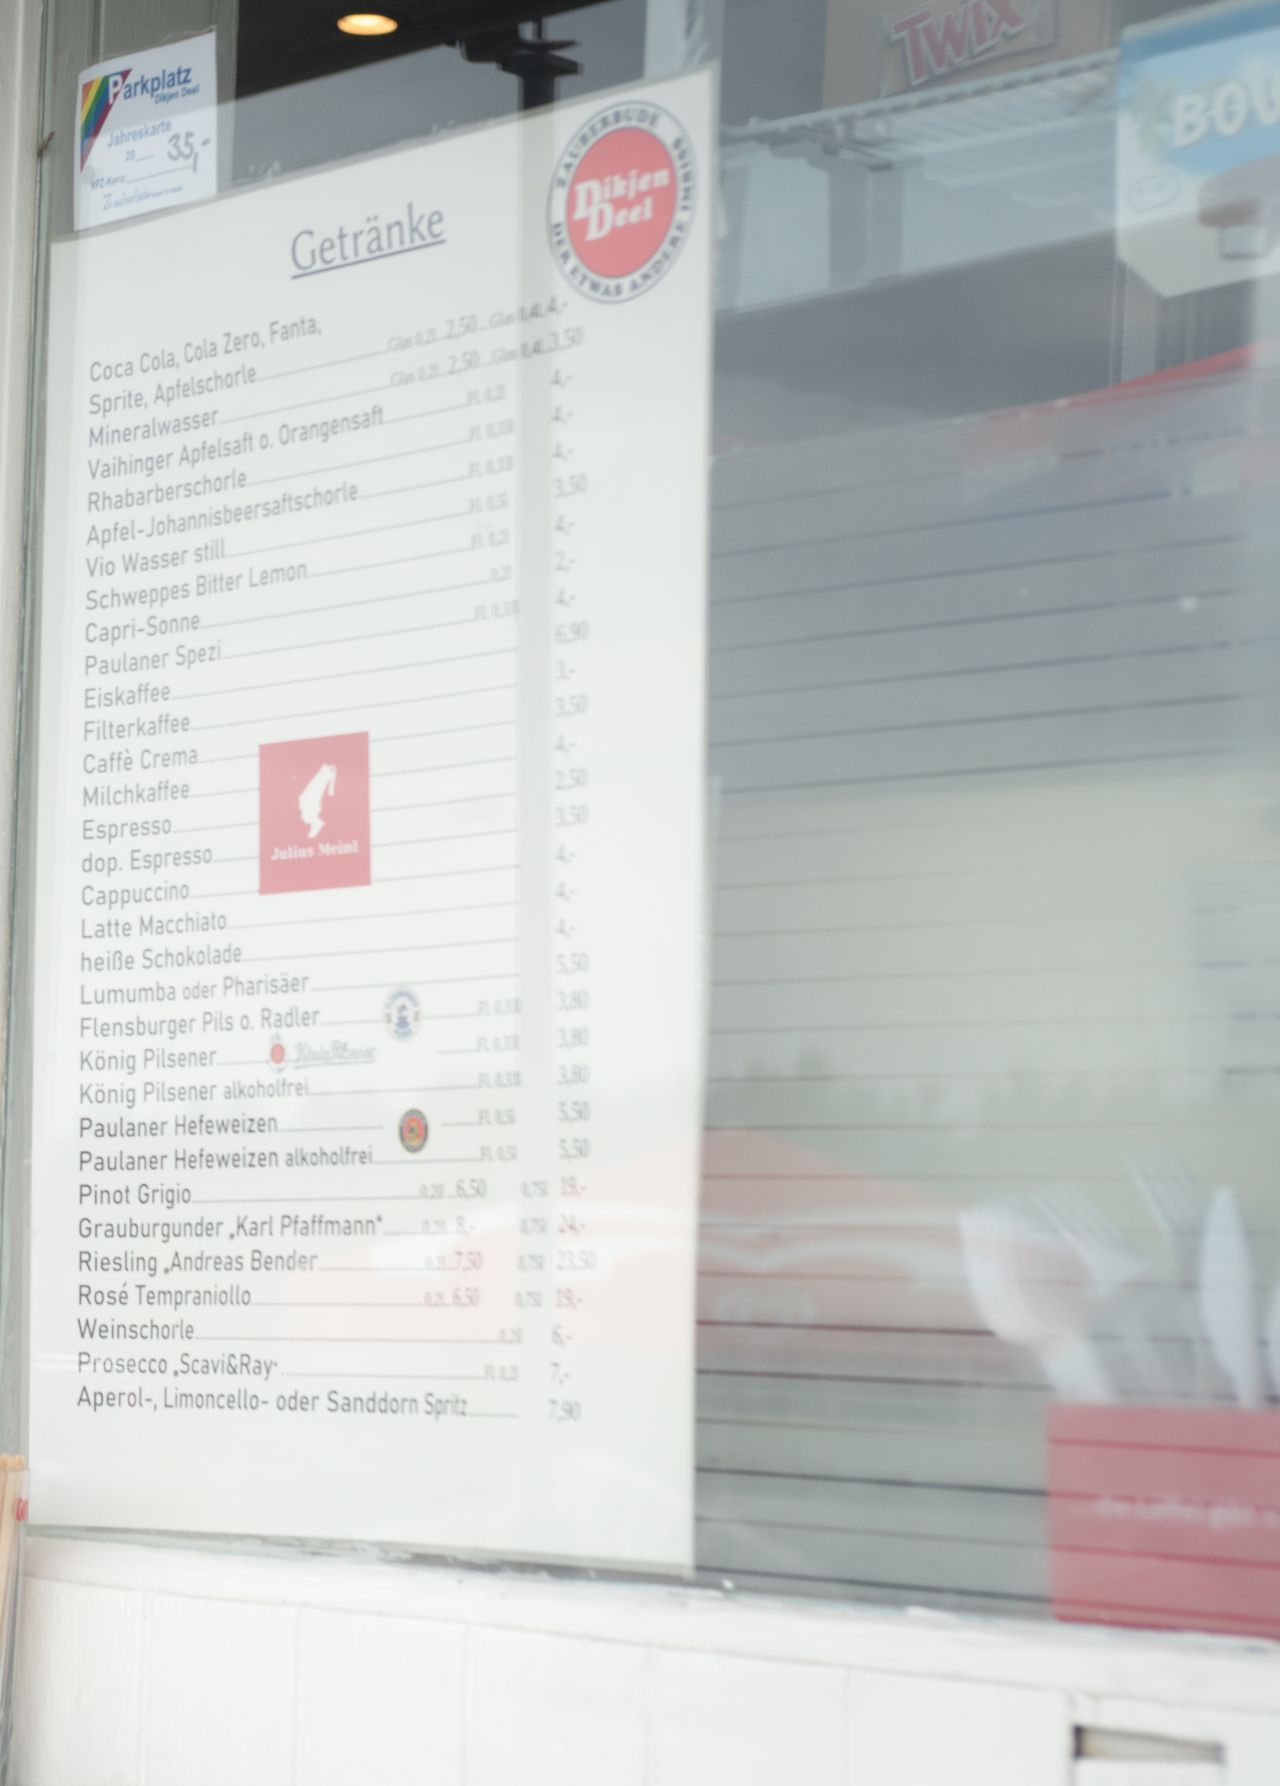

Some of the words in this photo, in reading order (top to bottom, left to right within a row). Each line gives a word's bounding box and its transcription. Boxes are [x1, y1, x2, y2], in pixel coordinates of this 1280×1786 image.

[108, 66, 193, 105] Parkplatz
[107, 120, 172, 148] Jahreskarte
[573, 168, 670, 221] Dikjen
[586, 196, 653, 241] Deel
[291, 202, 445, 271] Getränke
[90, 361, 134, 383] Coca
[139, 348, 180, 374] Cola,
[184, 338, 218, 364] Cola
[222, 332, 266, 355] Zero,
[269, 315, 323, 344] Fanta,
[89, 389, 148, 418] Sprite,
[154, 364, 258, 405] Apfelschorle
[87, 451, 174, 480] Vaihinger
[178, 432, 255, 469] Apfelsaft
[259, 434, 274, 450] o.
[278, 404, 385, 445] Orangensaft
[88, 409, 219, 448] Mineralwasser
[87, 468, 248, 512] Rhabarberschorle
[86, 480, 359, 548] Apfel-Johannisbeersaftschorle
[86, 556, 116, 578] Vio
[121, 549, 189, 574] Wasser
[194, 540, 226, 563] still
[85, 582, 190, 611] Schweppes
[195, 571, 244, 597] Bitter
[248, 562, 308, 588] Lemon
[85, 613, 201, 646] Capri-Sonne
[84, 650, 170, 677] Paulaner
[175, 639, 222, 670] Spezi
[84, 682, 171, 709] Eiskaffee
[83, 713, 191, 743] Filterkaffee
[83, 748, 133, 775] Caffè
[140, 747, 199, 771] Crema
[83, 780, 191, 808] Milchkaffee
[82, 818, 173, 845] Espresso
[81, 853, 123, 877] dop.
[130, 847, 213, 875] Espresso
[270, 844, 315, 861] Julius
[318, 840, 359, 857] Meinl
[81, 880, 190, 911] Cappuccino
[81, 917, 133, 940] Latte
[139, 911, 228, 937] Macchiato
[80, 949, 136, 973] heiße
[142, 942, 243, 971] Schokolade
[80, 980, 177, 1006] Lumumba
[181, 979, 217, 1000] oder
[223, 972, 310, 999] Pharisäer
[79, 1016, 197, 1041] Flensburger
[202, 1010, 235, 1034] Pils
[239, 1014, 255, 1031] o.
[260, 1007, 321, 1030] Radler
[79, 1049, 137, 1076] König
[143, 1047, 217, 1071] Pilsener
[79, 1083, 136, 1109] König
[143, 1080, 217, 1105] Pilsener
[223, 1076, 310, 1101] alkoholfrei
[79, 1116, 169, 1139] Paulaner
[174, 1113, 278, 1137] Hefeweizen
[79, 1150, 168, 1172] Paulaner
[173, 1146, 279, 1170] Hefeweizen
[284, 1145, 374, 1169] alkoholfrei
[79, 1182, 131, 1206] Pinot
[137, 1182, 192, 1209] Grigio
[78, 1217, 224, 1243] Grauburgunder
[78, 1250, 159, 1277] Riesling
[250, 1249, 318, 1273] Bender
[77, 1281, 129, 1307] Rosé
[134, 1282, 252, 1311] Tempraniollo
[77, 1317, 195, 1342] Weinschorle
[77, 1351, 168, 1376] Prosecco
[76, 1385, 158, 1413] Aperol-,
[163, 1386, 270, 1412] Limoncello-
[276, 1390, 320, 1413] oder
[326, 1389, 419, 1415] Sanddorn
[423, 1391, 469, 1420] Spritz
